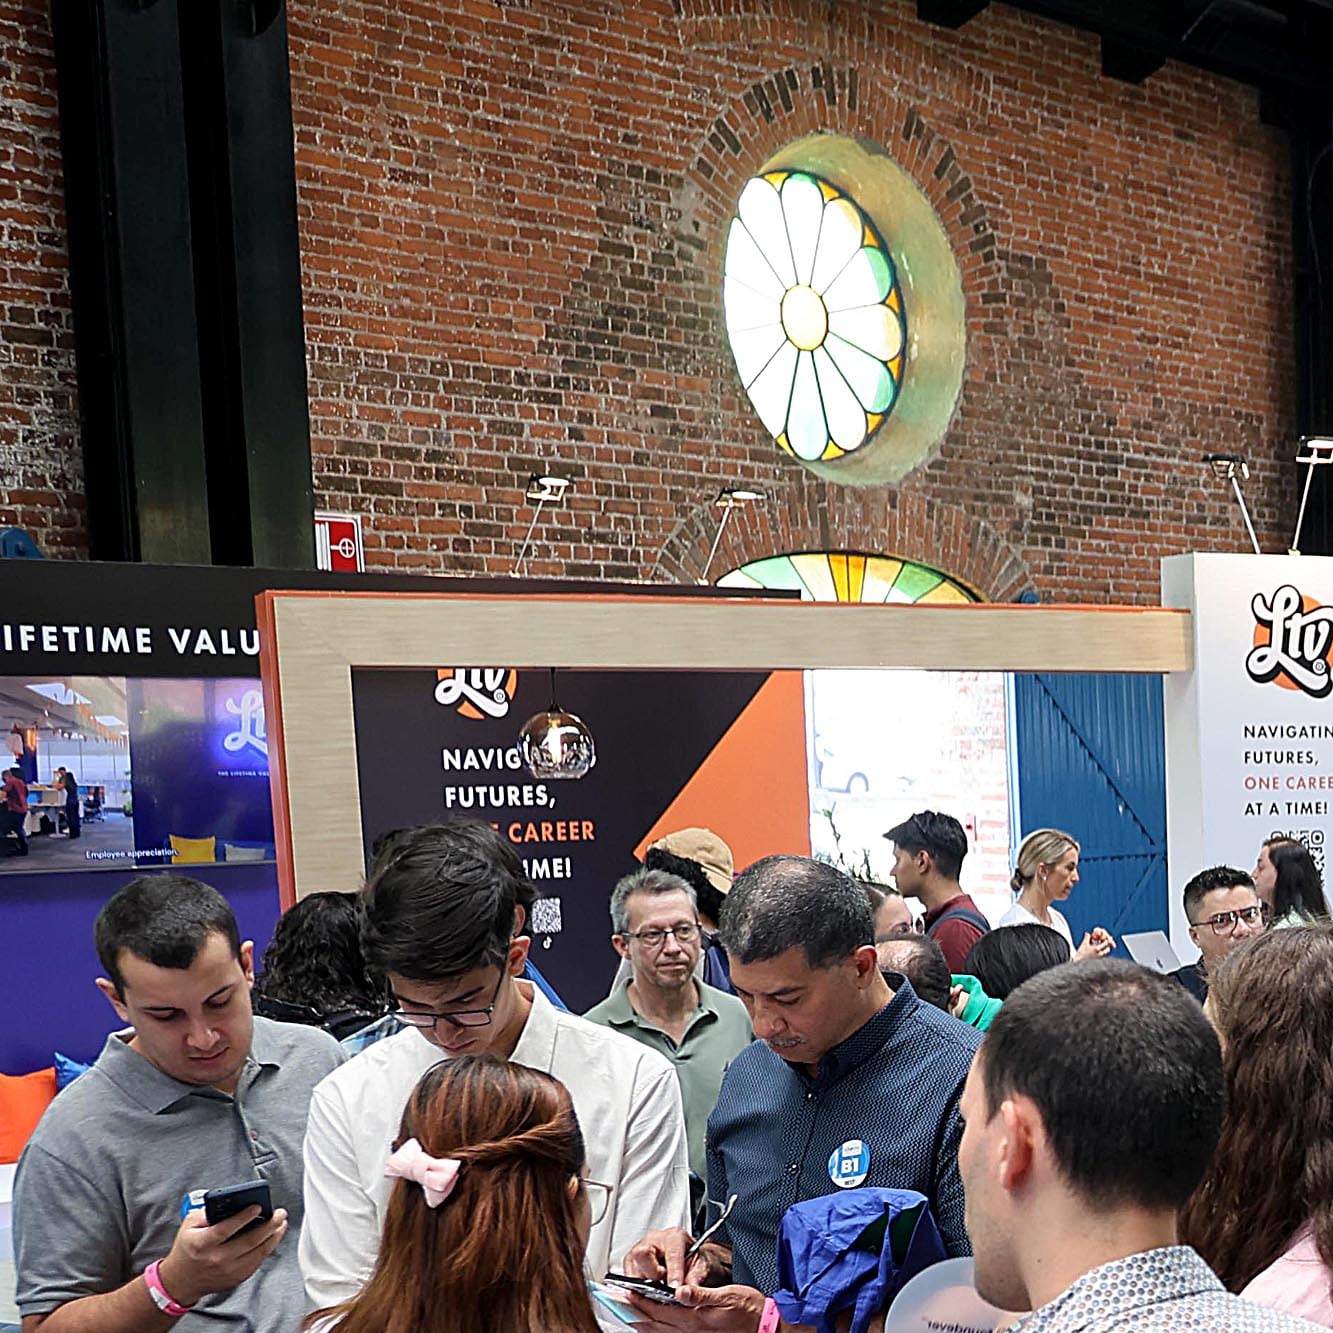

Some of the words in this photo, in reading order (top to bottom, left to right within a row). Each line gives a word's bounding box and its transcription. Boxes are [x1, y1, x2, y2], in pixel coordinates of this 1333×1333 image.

[3, 624, 152, 653] IFETIME
[1244, 751, 1320, 766] FUTURES,
[1244, 776, 1280, 790] ONE
[445, 785, 556, 809] FUTURES,
[1244, 802, 1264, 816] AT
[1269, 802, 1280, 815] A
[1285, 801, 1328, 815] TIME!
[508, 820, 596, 843] CAREER
[86, 850, 125, 860] Employee
[841, 1157, 859, 1174] B1
